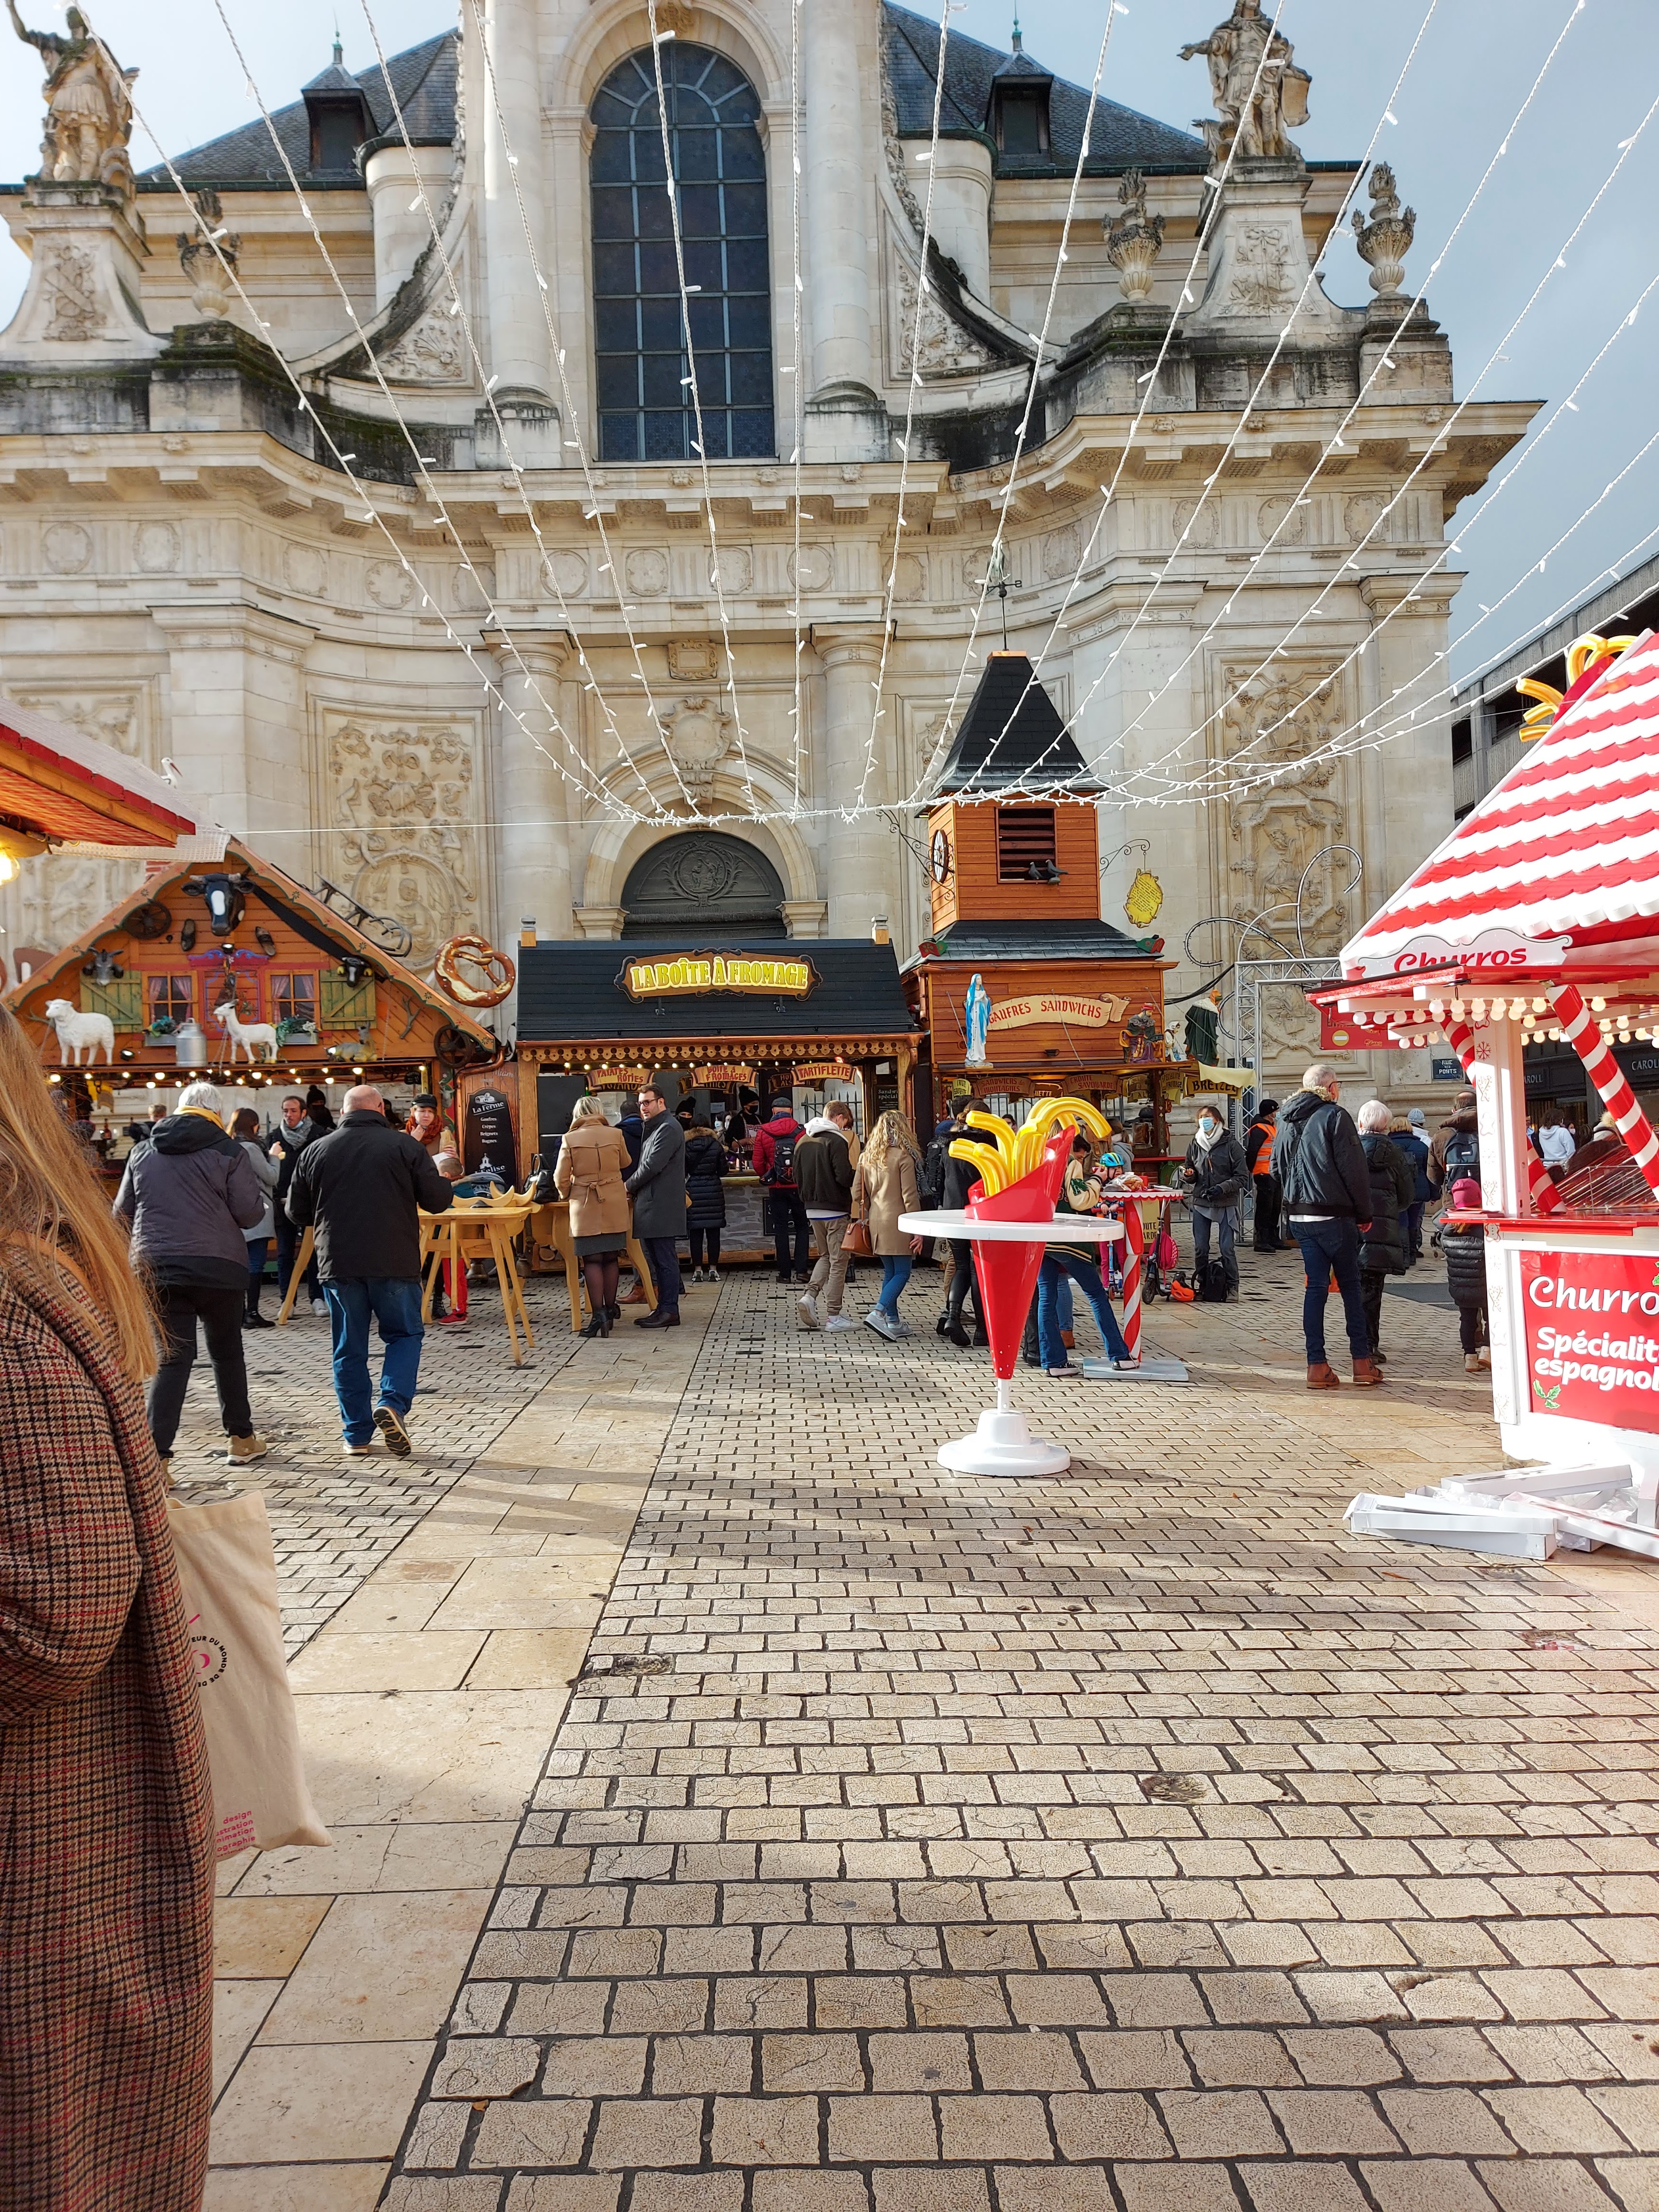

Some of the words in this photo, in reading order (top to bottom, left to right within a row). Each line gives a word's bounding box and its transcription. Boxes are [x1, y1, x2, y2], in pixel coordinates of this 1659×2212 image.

[632, 967, 656, 989] LA
[656, 958, 709, 987] BOÎTE
[714, 958, 727, 984] À
[729, 961, 807, 987] FROMAGE
[988, 1002, 1031, 1024] GAUFRES
[1040, 1000, 1102, 1019] SANDWICHS
[1632, 1059, 1659, 1071] CAROL
[1536, 1326, 1659, 1363] Spécialit
[209, 1637, 220, 1646] DU
[218, 1645, 227, 1673] MONDE
[209, 1674, 220, 1683] DE
[223, 1810, 252, 1824] design
